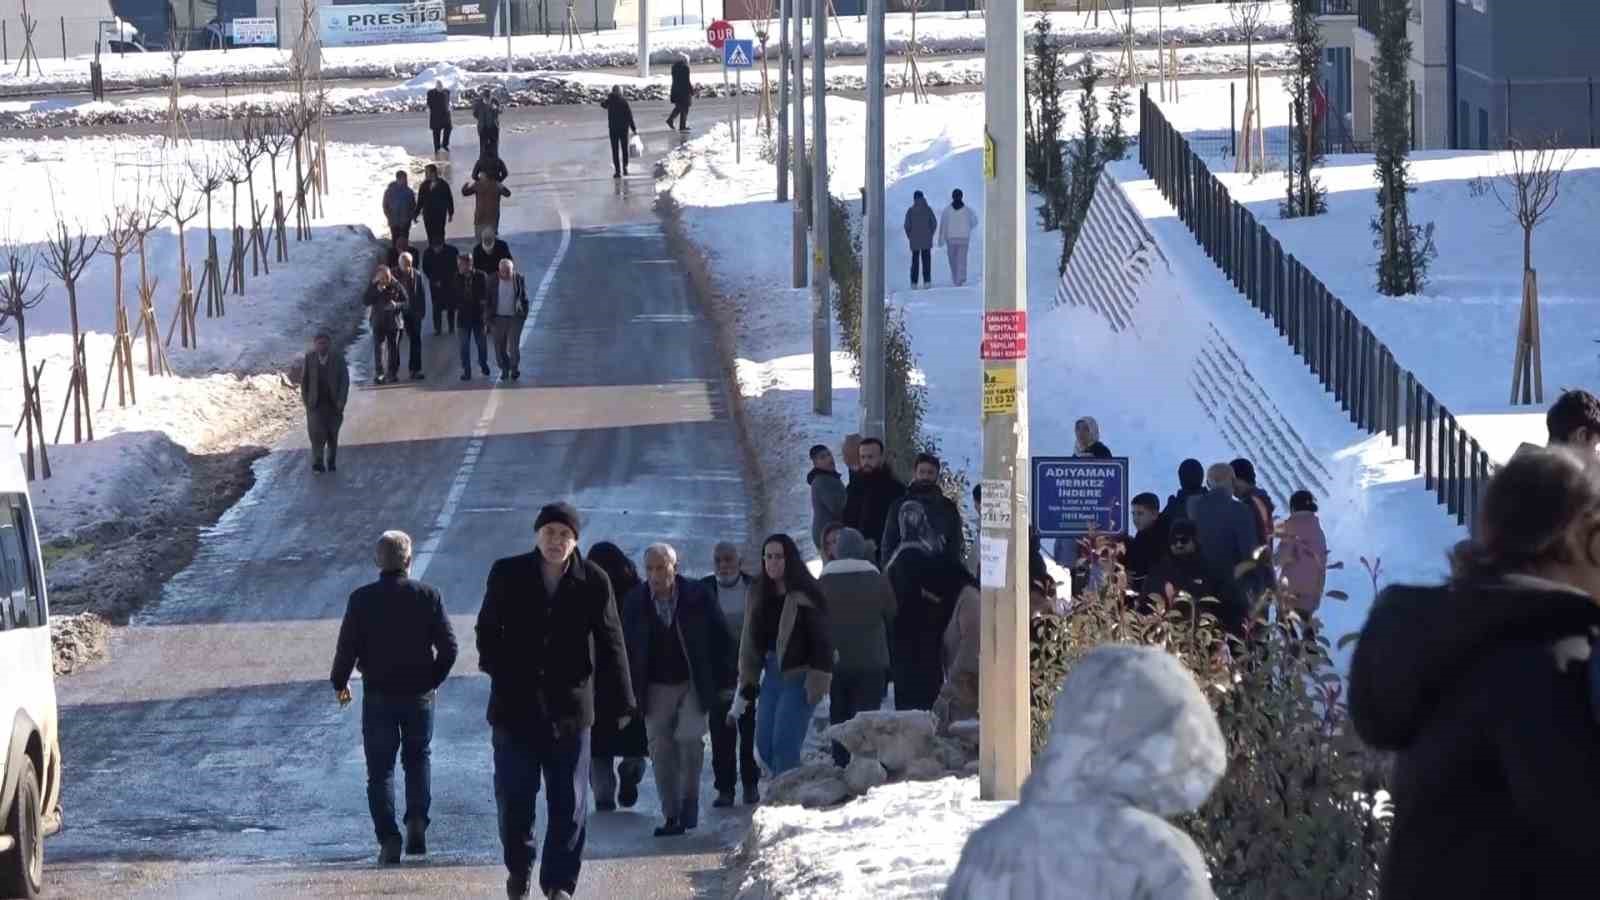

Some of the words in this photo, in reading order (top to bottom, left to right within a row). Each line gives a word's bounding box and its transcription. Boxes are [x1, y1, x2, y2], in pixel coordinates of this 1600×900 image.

[709, 29, 733, 41] DUR
[1046, 468, 1115, 477] ADIYAMAN
[1056, 479, 1104, 488] MERKEZ
[1058, 488, 1102, 498] İNDERE
